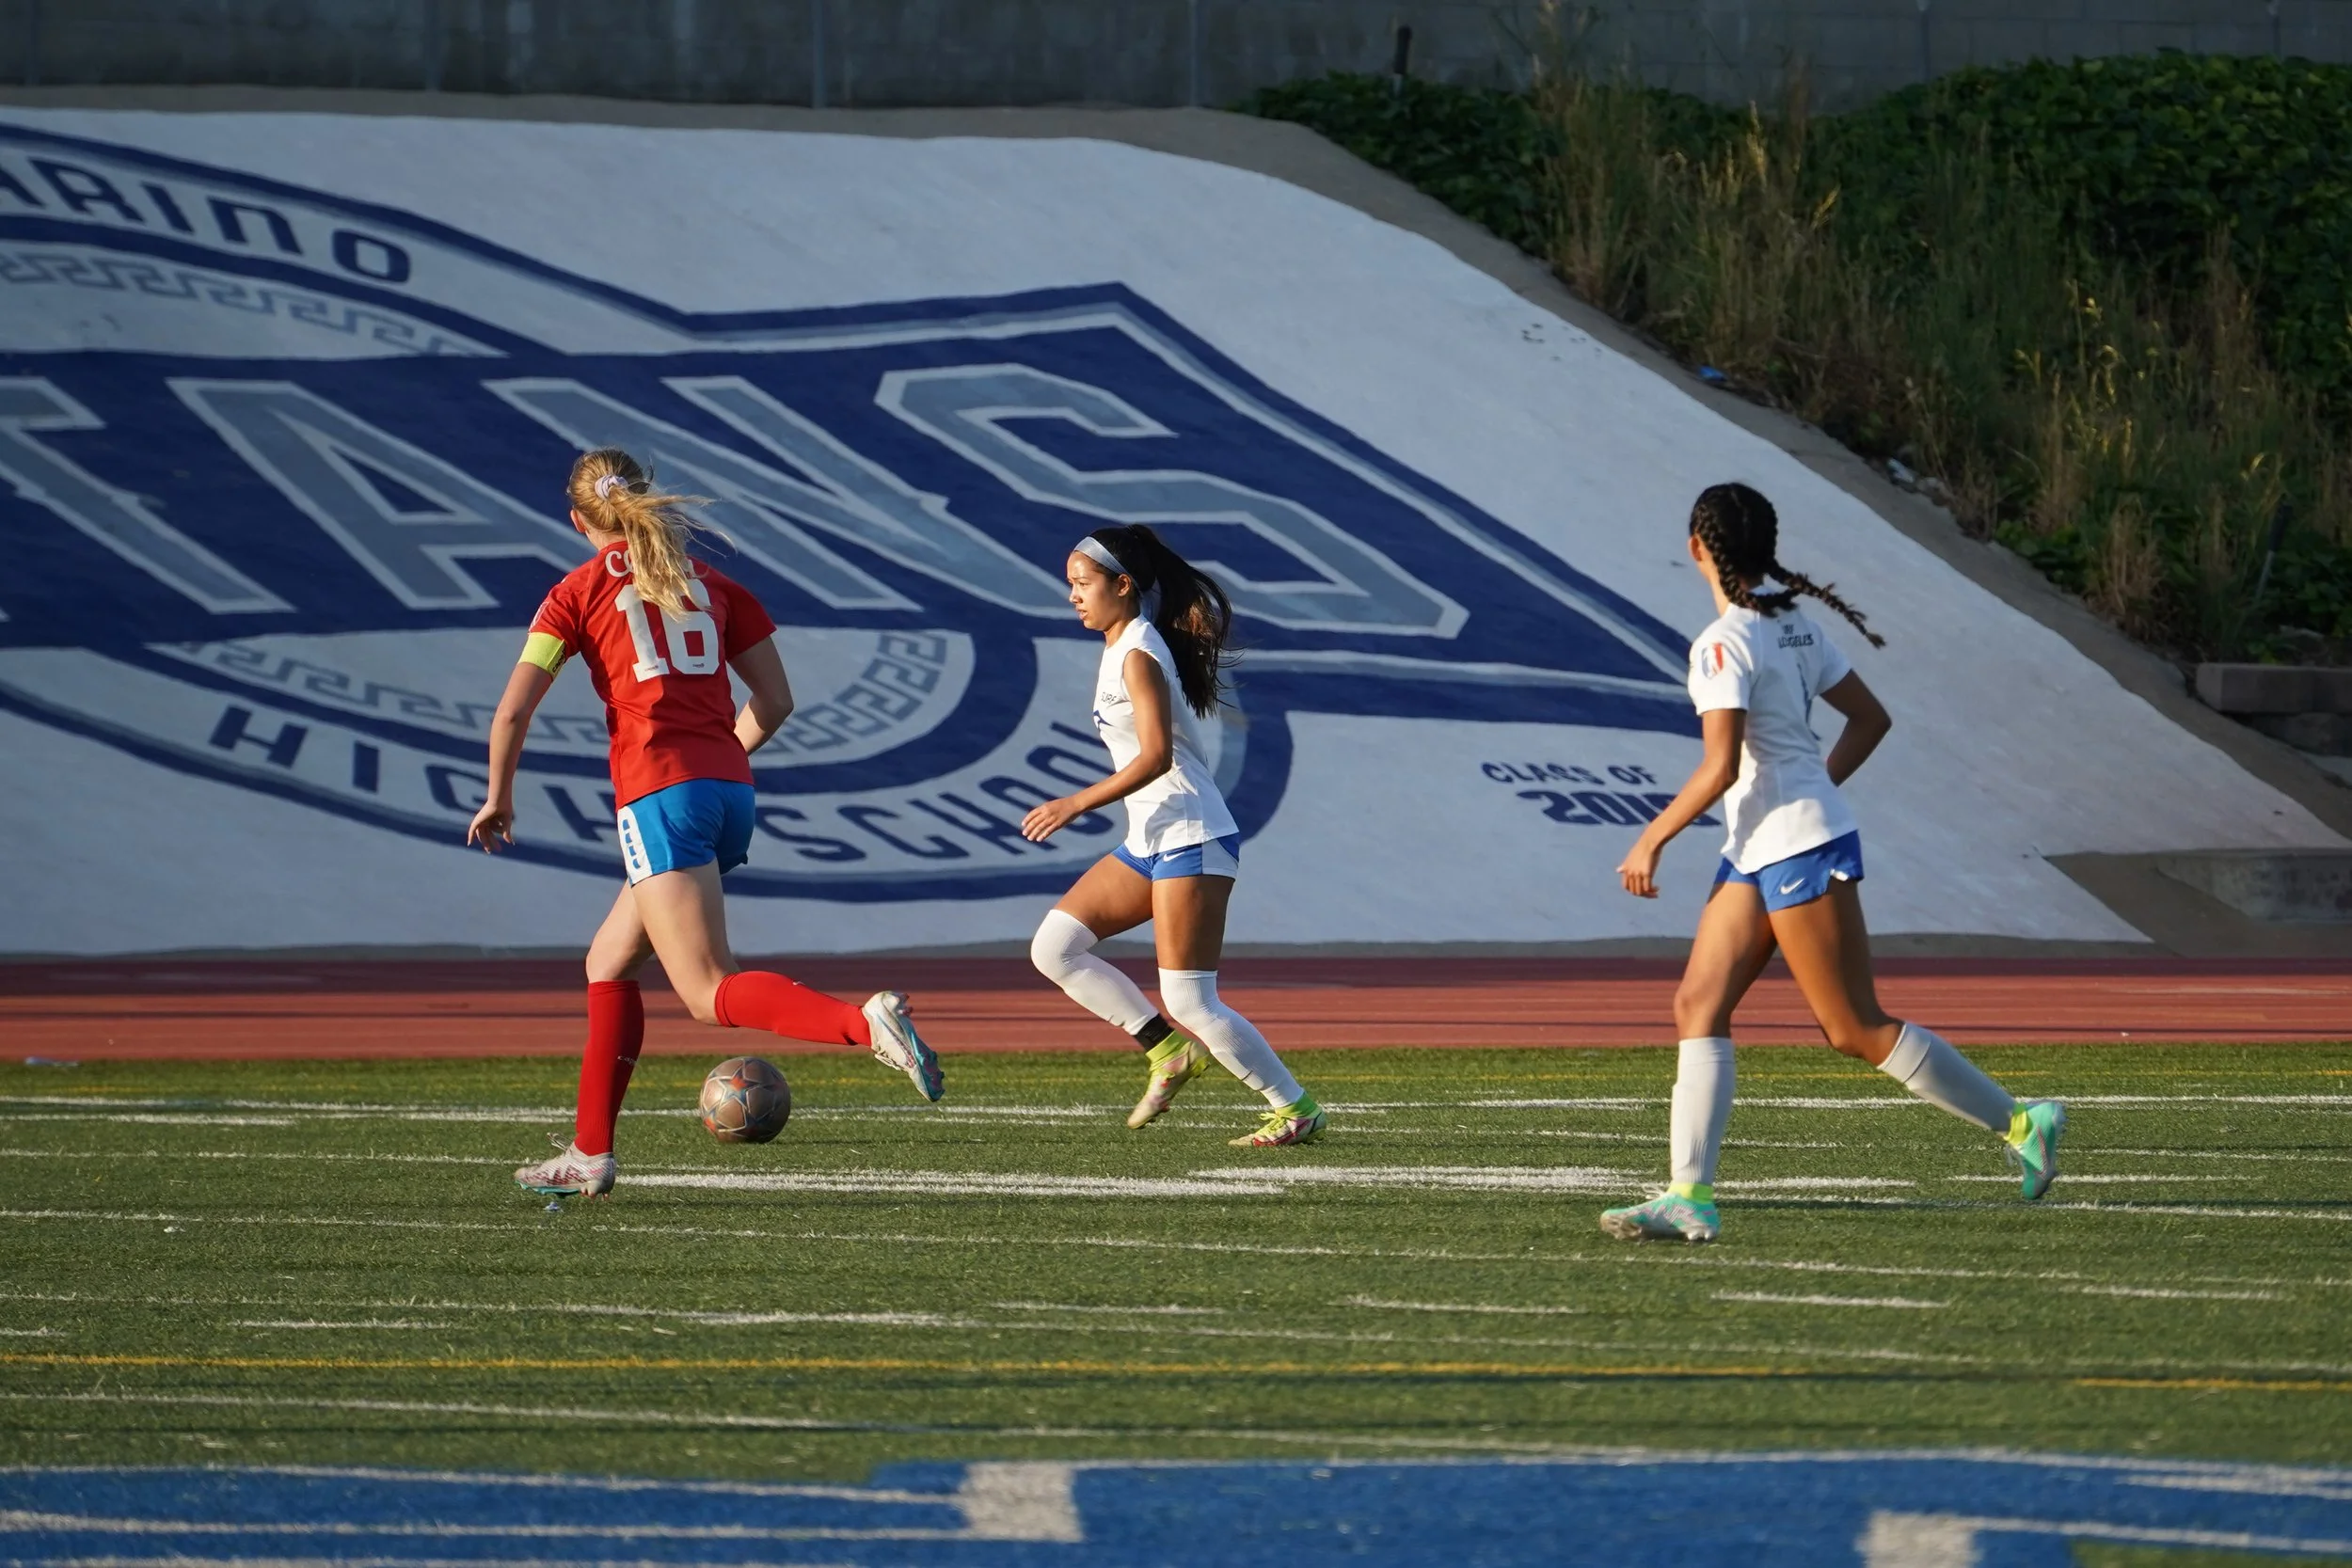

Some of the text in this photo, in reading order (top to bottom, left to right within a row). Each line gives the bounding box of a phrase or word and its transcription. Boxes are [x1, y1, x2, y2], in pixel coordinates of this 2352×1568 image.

[0, 363, 1470, 640] TANS
[614, 578, 720, 683] 16
[1481, 762, 1658, 785] CLASS OF
